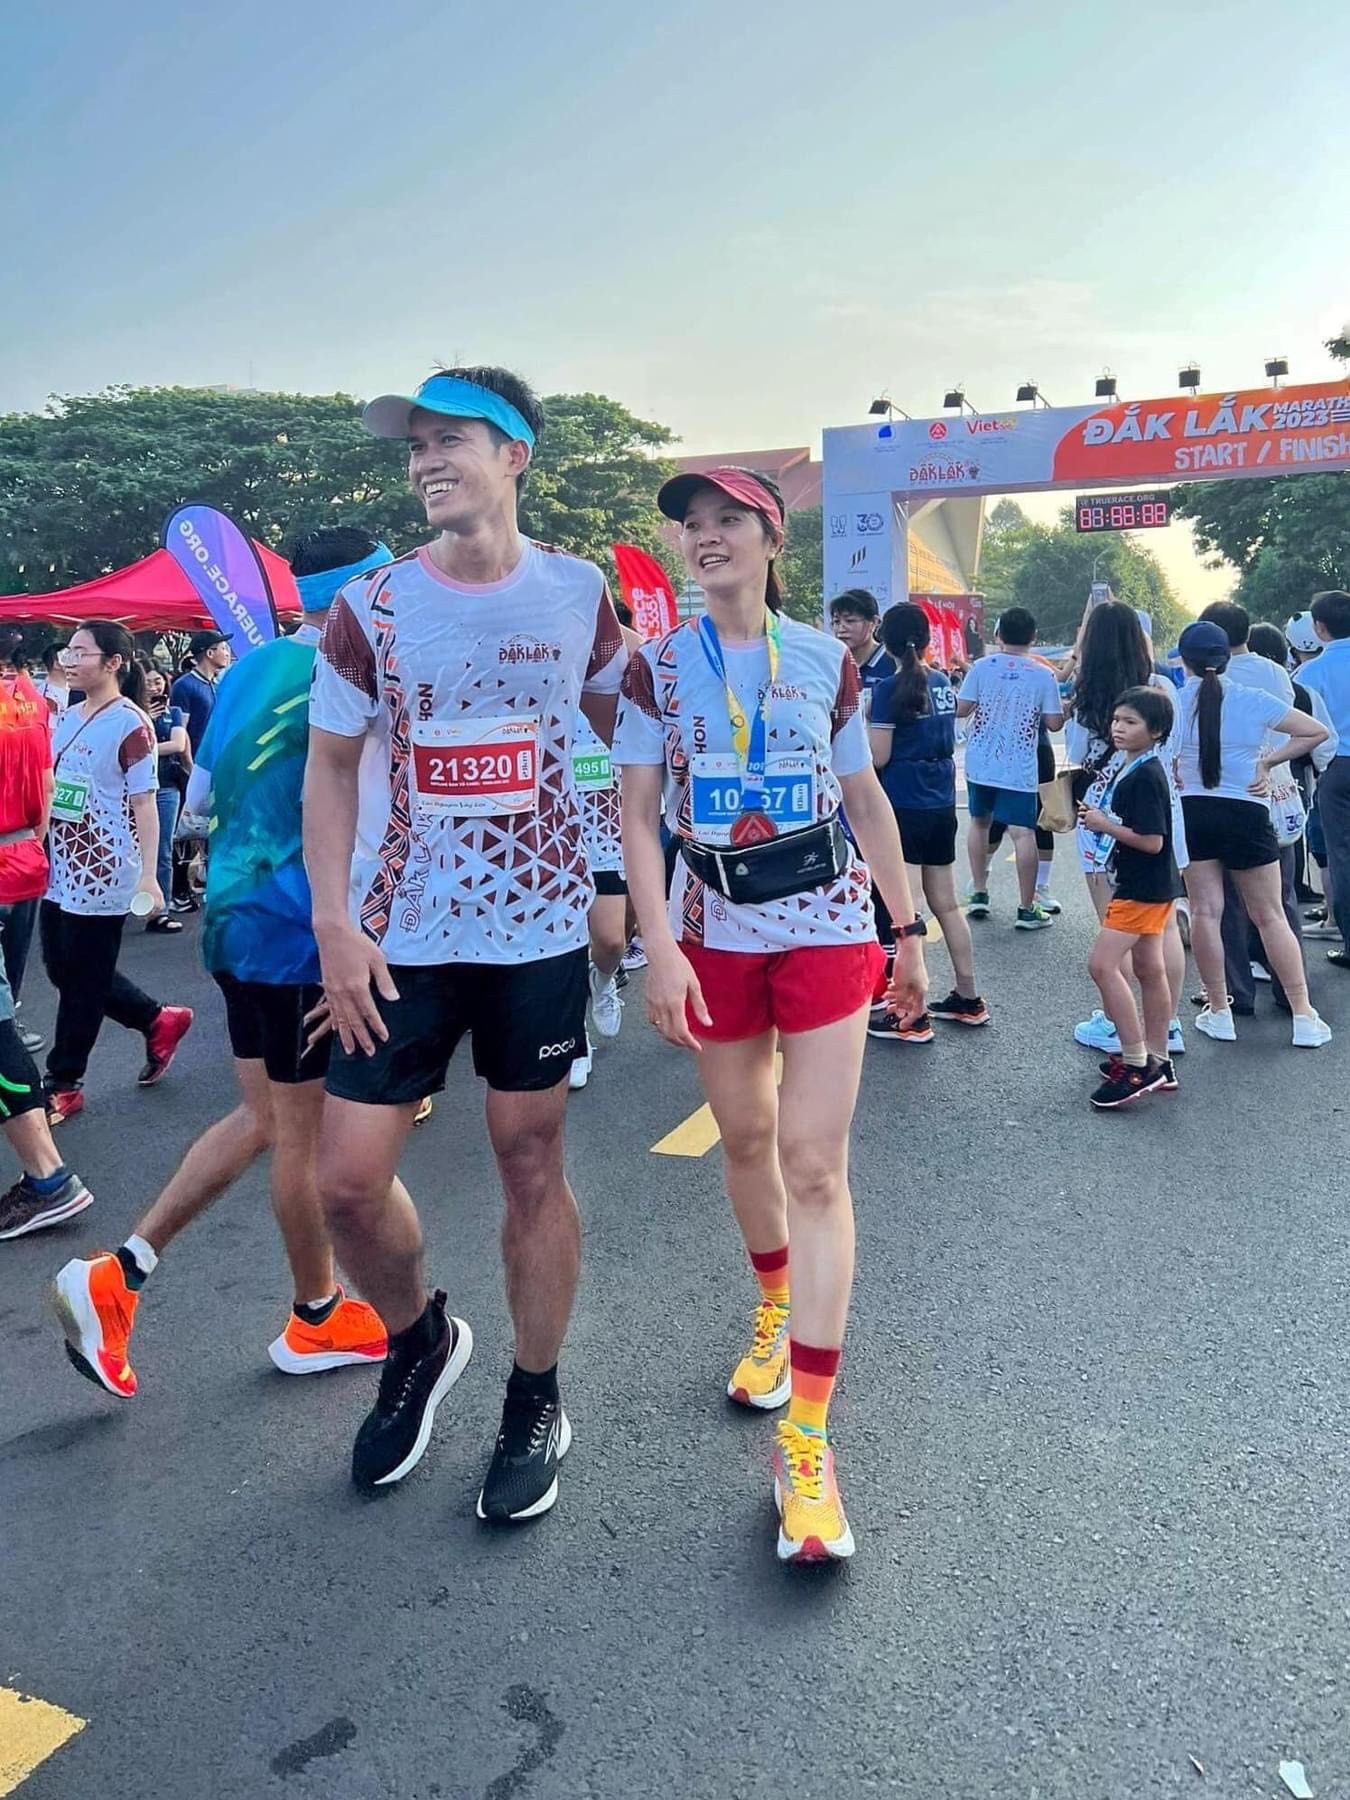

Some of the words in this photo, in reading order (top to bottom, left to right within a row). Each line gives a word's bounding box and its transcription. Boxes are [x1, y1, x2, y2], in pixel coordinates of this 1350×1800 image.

[1083, 403, 1174, 446] ĐẮK
[1184, 394, 1273, 438] LẮK
[1272, 409, 1330, 430] 2023
[1174, 442, 1248, 470] START
[428, 755, 513, 782] 21320
[709, 786, 787, 811] 1067
